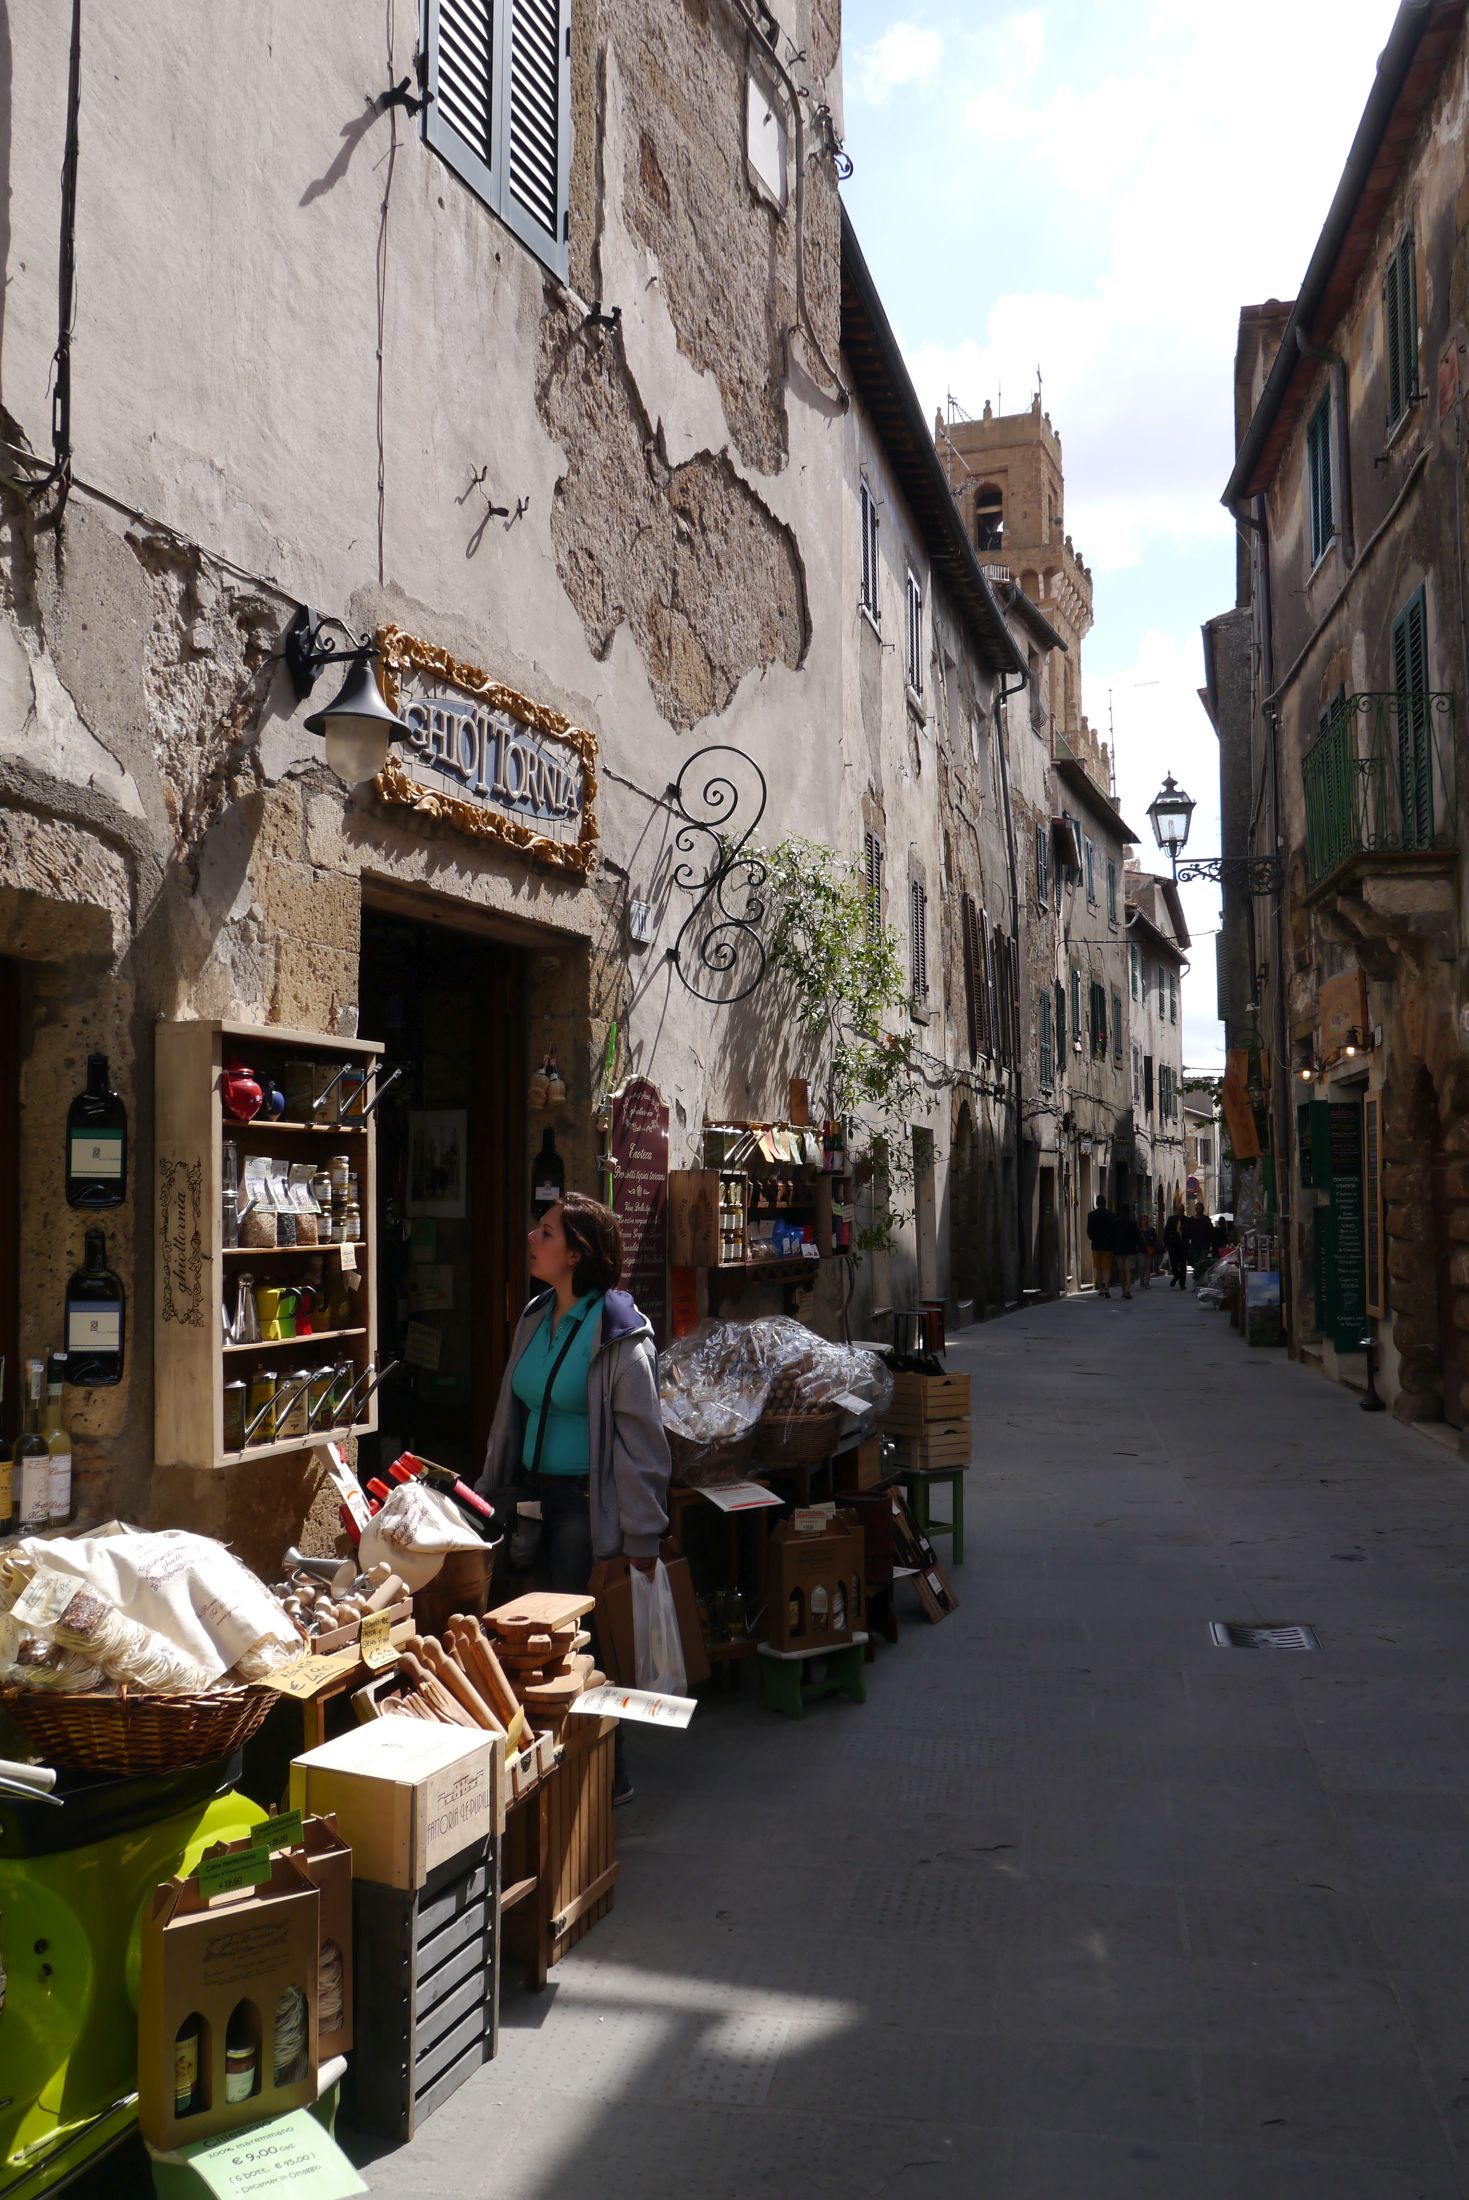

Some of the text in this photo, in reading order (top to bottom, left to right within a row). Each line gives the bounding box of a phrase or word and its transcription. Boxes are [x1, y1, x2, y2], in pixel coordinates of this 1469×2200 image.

[402, 703, 579, 815] GHIOTTORNIA
[628, 1143, 652, 1160] Enoteca
[172, 1189, 194, 1296] ghiottornia
[427, 1807, 459, 1846] FATTORIA
[469, 1788, 491, 1817] PUPILL
[232, 2156, 244, 2165] €
[245, 2145, 278, 2162] 9,00
[236, 2126, 294, 2149] maremmano
